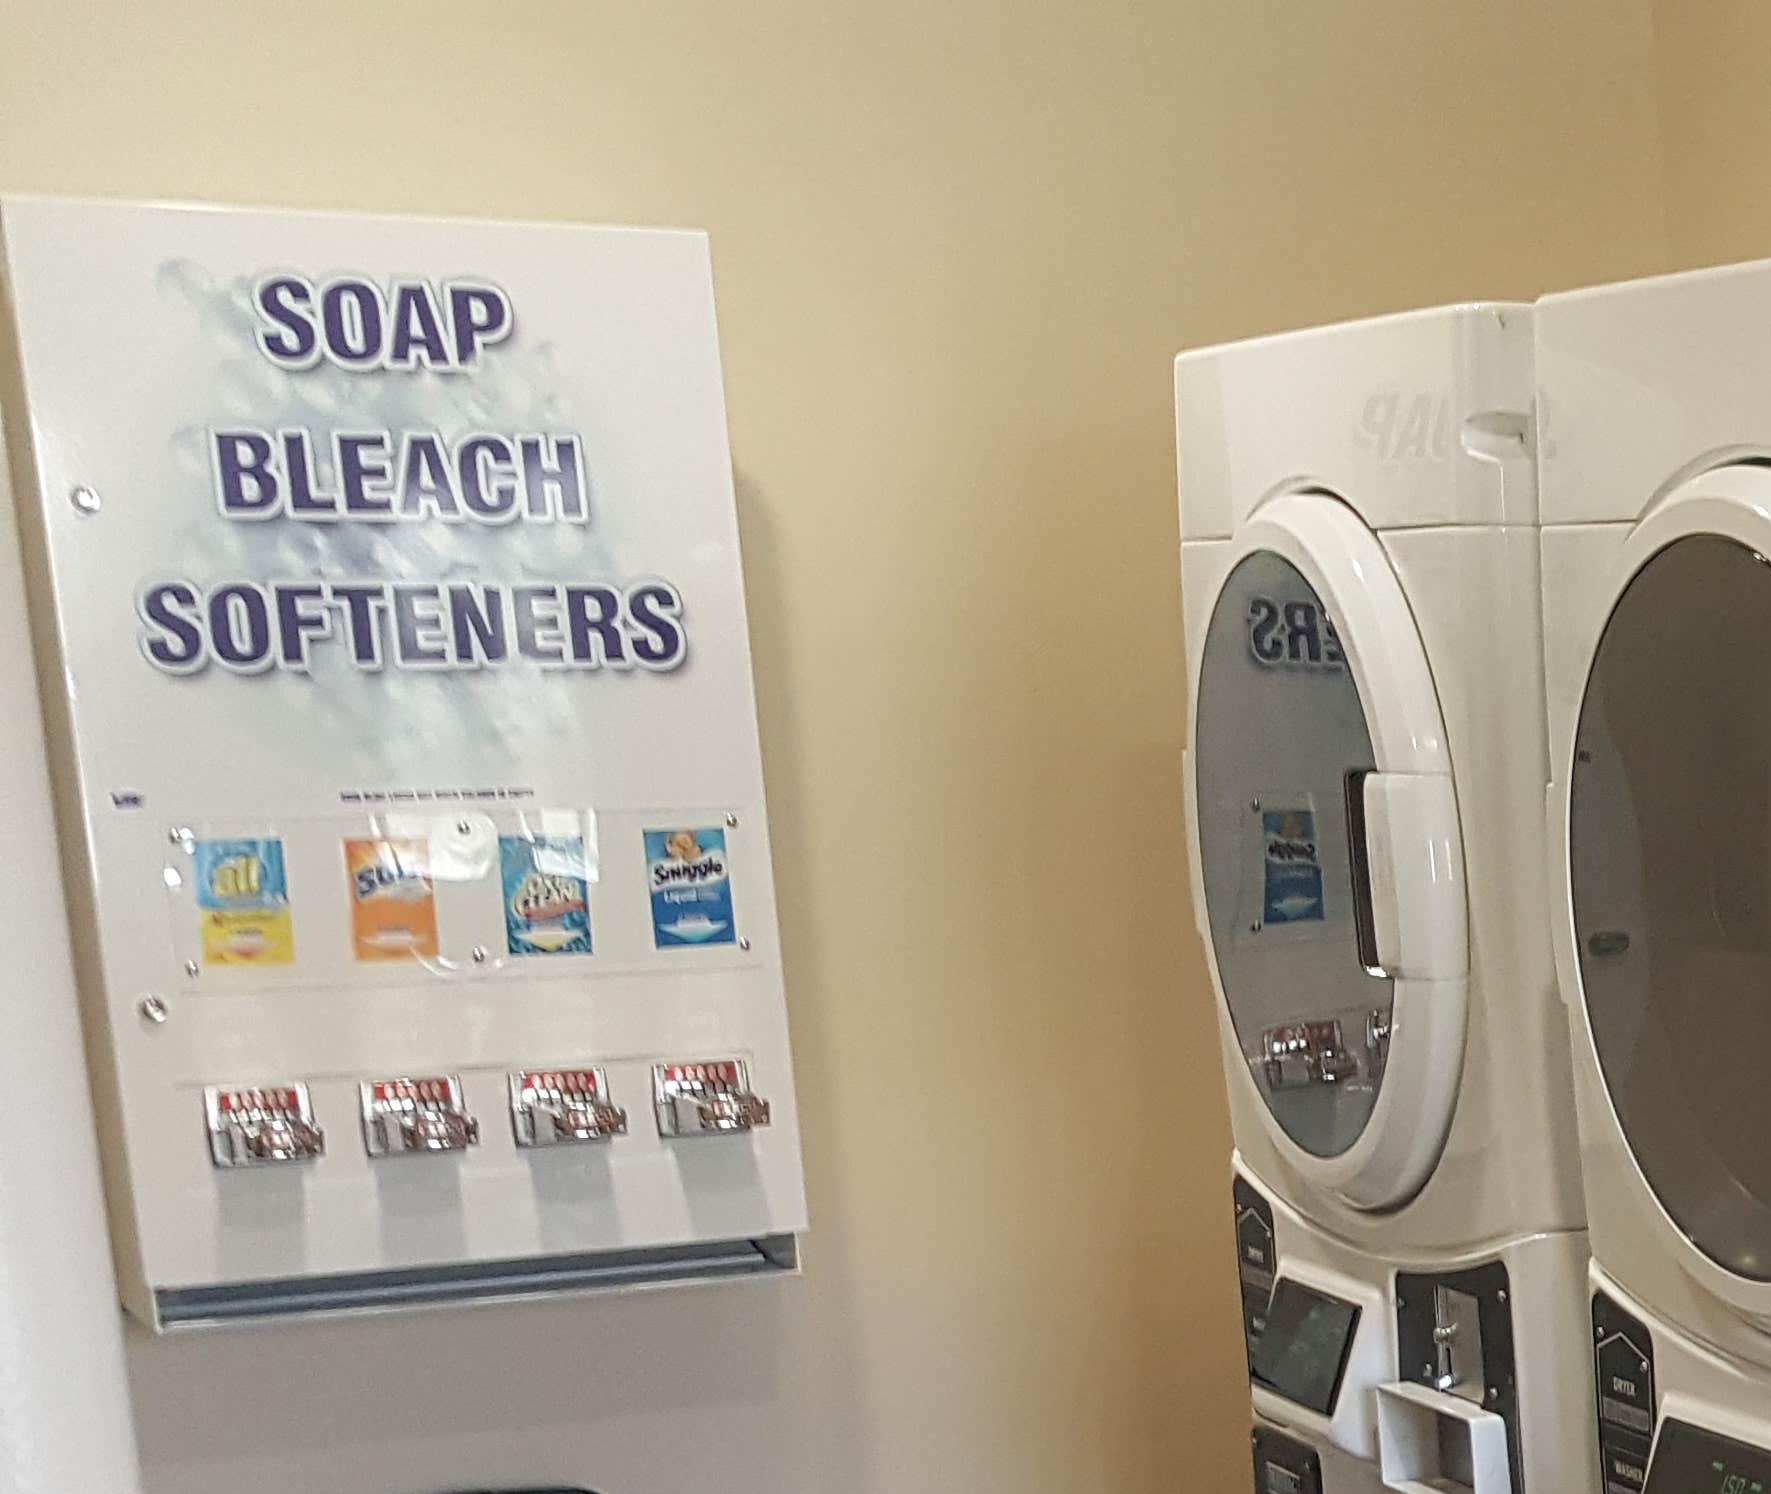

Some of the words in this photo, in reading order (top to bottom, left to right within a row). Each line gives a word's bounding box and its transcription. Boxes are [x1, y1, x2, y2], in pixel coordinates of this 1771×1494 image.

[256, 277, 507, 367] SOAP
[213, 431, 584, 516] BLEACH
[140, 582, 684, 665] SOFTENERS
[213, 856, 259, 899] all
